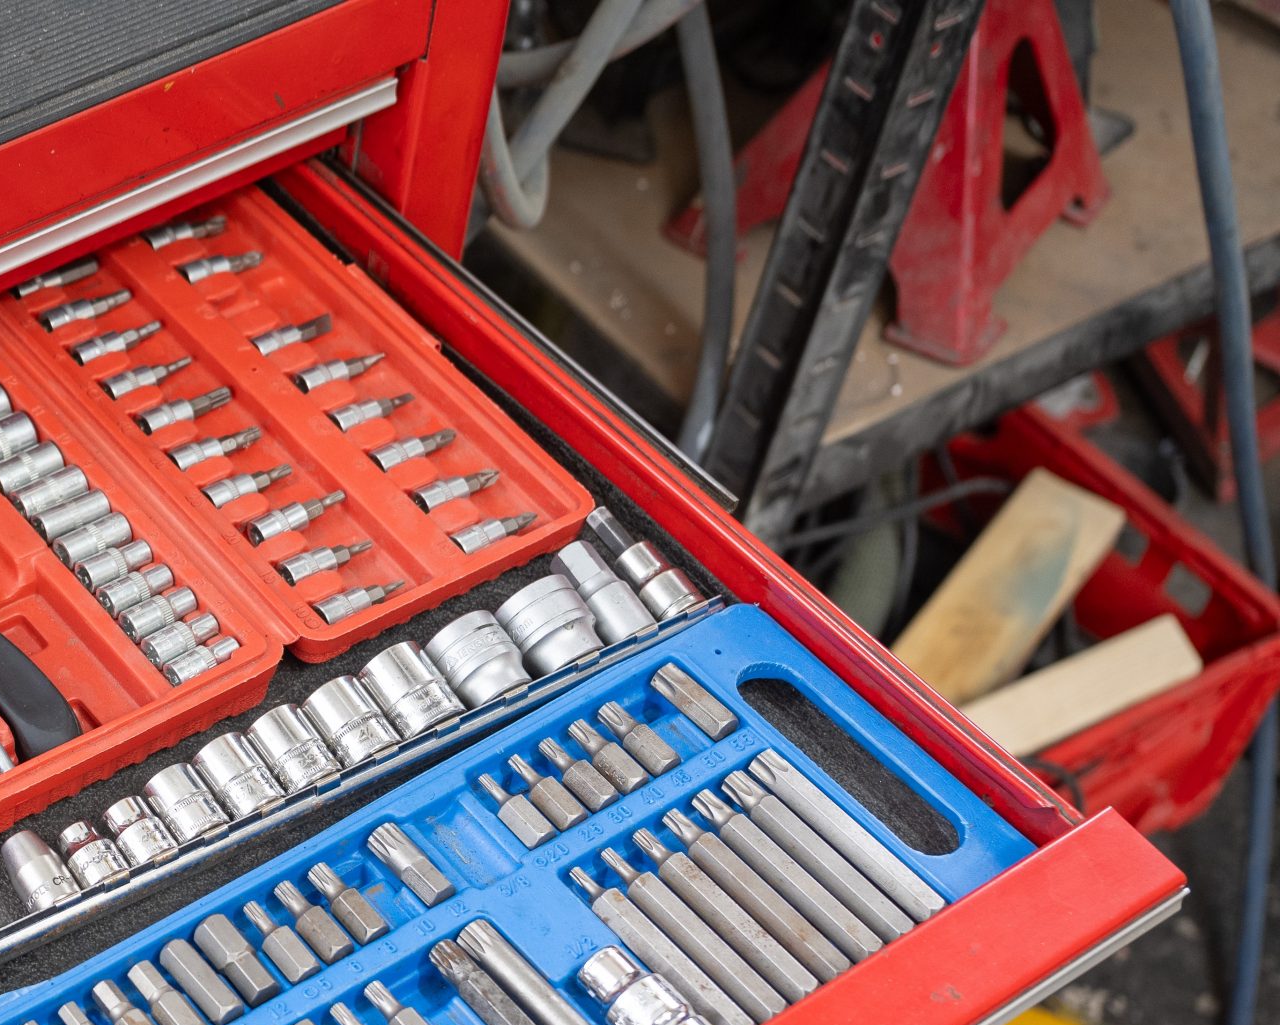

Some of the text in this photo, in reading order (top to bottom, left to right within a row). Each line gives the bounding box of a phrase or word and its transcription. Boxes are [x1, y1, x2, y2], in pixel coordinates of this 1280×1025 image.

[544, 734, 756, 863] 20 25 30 40 45 50 55
[498, 875, 531, 897] 3/8
[413, 919, 436, 935] 10
[446, 901, 469, 918] 12
[569, 935, 599, 959] 1/2
[271, 1002, 291, 1020] 12
